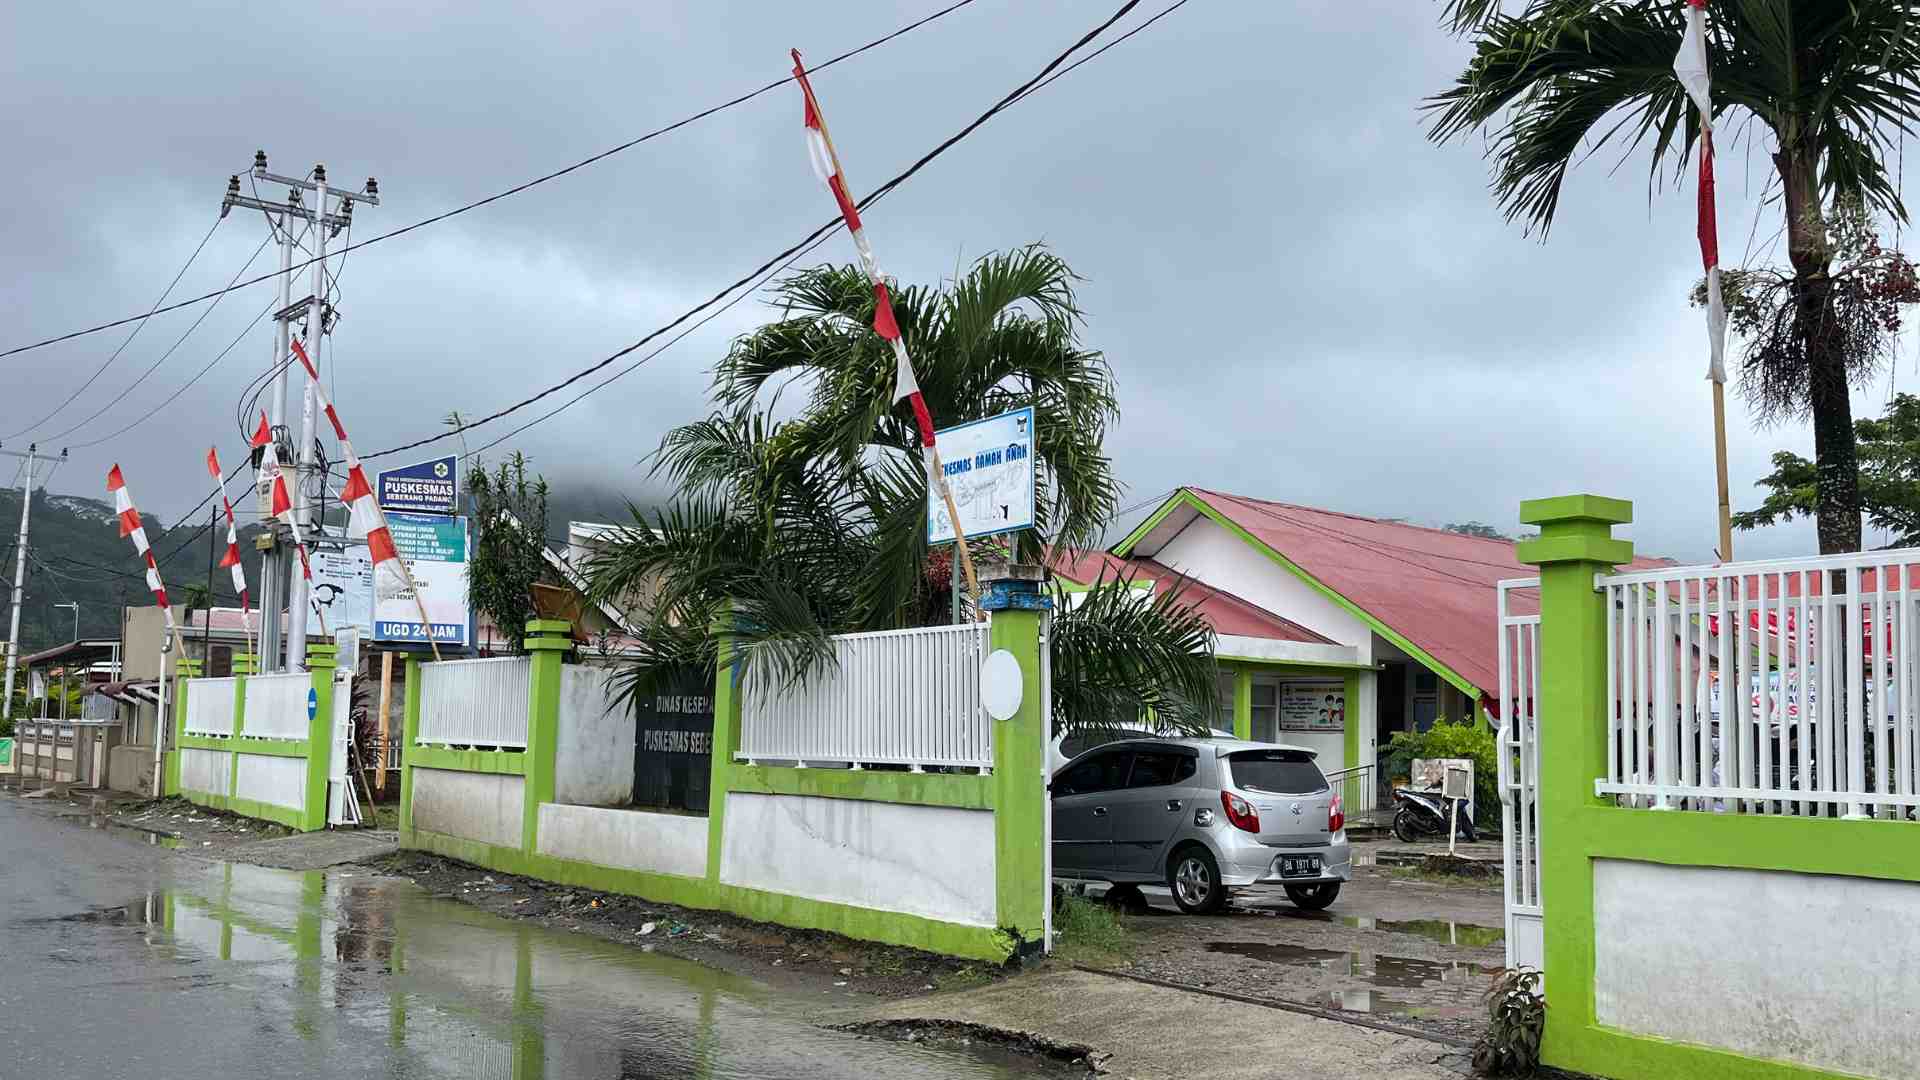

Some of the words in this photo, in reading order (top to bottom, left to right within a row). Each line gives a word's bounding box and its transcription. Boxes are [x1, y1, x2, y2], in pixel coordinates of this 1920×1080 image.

[943, 458, 972, 477] KESMAS
[1006, 444, 1028, 462] ANAK
[384, 482, 454, 496] PUSKESMAS
[386, 493, 424, 502] SEBERANG
[383, 623, 409, 636] UGD
[413, 625, 427, 637] 24
[432, 626, 456, 638] JAM
[656, 696, 680, 713] DINAS
[644, 729, 689, 752] PUSKESMAS
